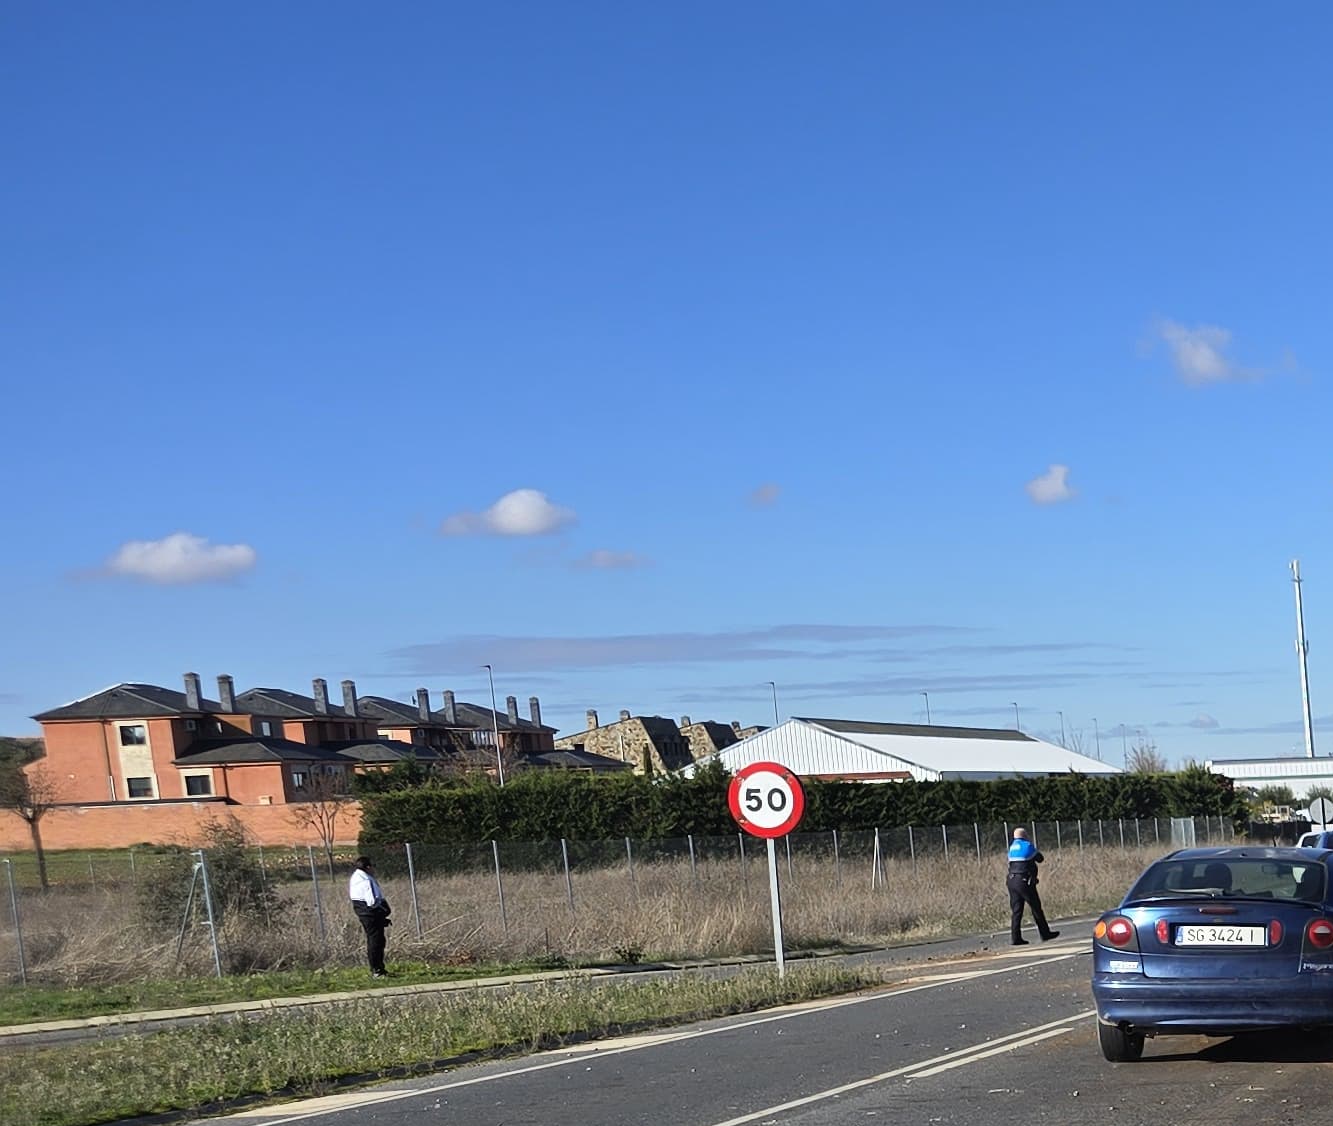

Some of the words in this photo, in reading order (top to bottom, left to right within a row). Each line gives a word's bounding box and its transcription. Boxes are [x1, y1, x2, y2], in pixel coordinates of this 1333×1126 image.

[745, 788, 787, 812] 50
[1187, 928, 1205, 942] SG
[1208, 928, 1243, 942] 3424
